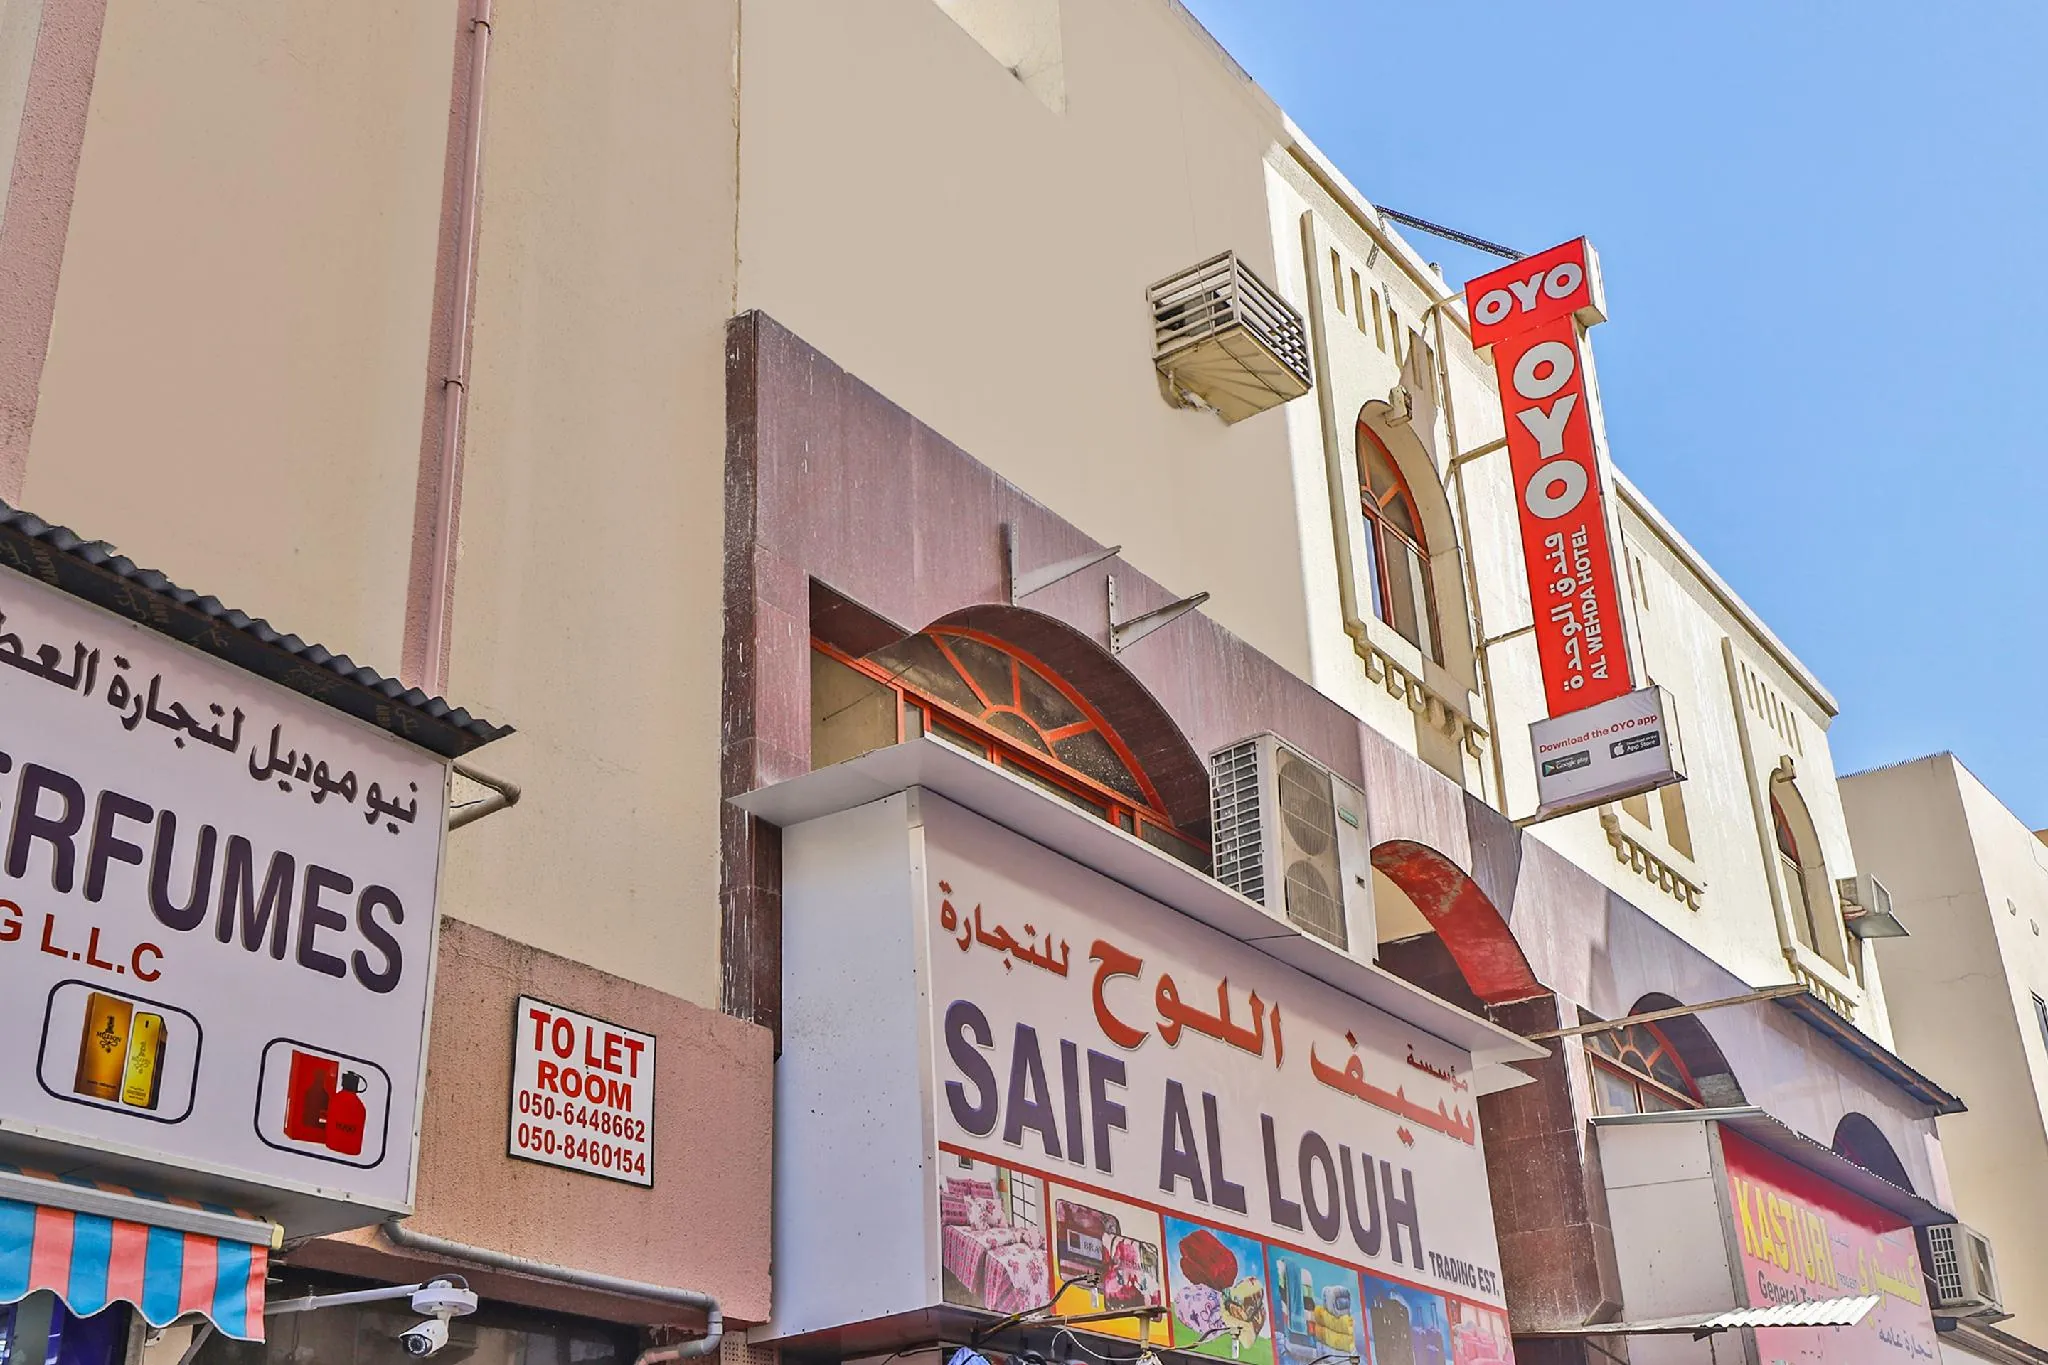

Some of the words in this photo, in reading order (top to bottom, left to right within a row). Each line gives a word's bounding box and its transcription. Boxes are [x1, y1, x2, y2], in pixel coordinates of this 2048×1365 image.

[1474, 261, 1583, 325] OYO
[1512, 340, 1589, 520] OYO
[1545, 532, 1577, 598] فندق
[1571, 524, 1593, 586] HOTEL
[1551, 602, 1584, 691] الوحدة
[1580, 586, 1604, 656] WEHDA
[1592, 655, 1608, 679] AL
[107, 654, 245, 754] لتجارة
[1539, 731, 1590, 753] Download
[1591, 728, 1609, 738] the
[1610, 719, 1635, 733] OYO
[1637, 714, 1658, 727] app
[248, 724, 359, 804] موديل
[364, 780, 419, 834] نيو
[0, 751, 405, 993] RFUMES
[40, 913, 164, 982] L.L.C
[939, 879, 1071, 977] للتجارة
[1088, 937, 1284, 1069] اللوح
[529, 1008, 575, 1059] TO
[584, 1026, 645, 1078] LET
[1406, 1042, 1469, 1093] مؤسسة
[519, 1090, 645, 1142] 050-6448662
[537, 1059, 632, 1112] ROOM
[1310, 1029, 1476, 1147] سيف
[518, 1123, 646, 1176] 050-8460154
[944, 1000, 1129, 1176] SAIF
[1158, 1077, 1247, 1217] AL
[1260, 1112, 1425, 1271] LOUH
[1477, 1267, 1500, 1297] EST.
[1734, 1176, 1839, 1291] KASTURI
[1758, 1270, 1799, 1303] General
